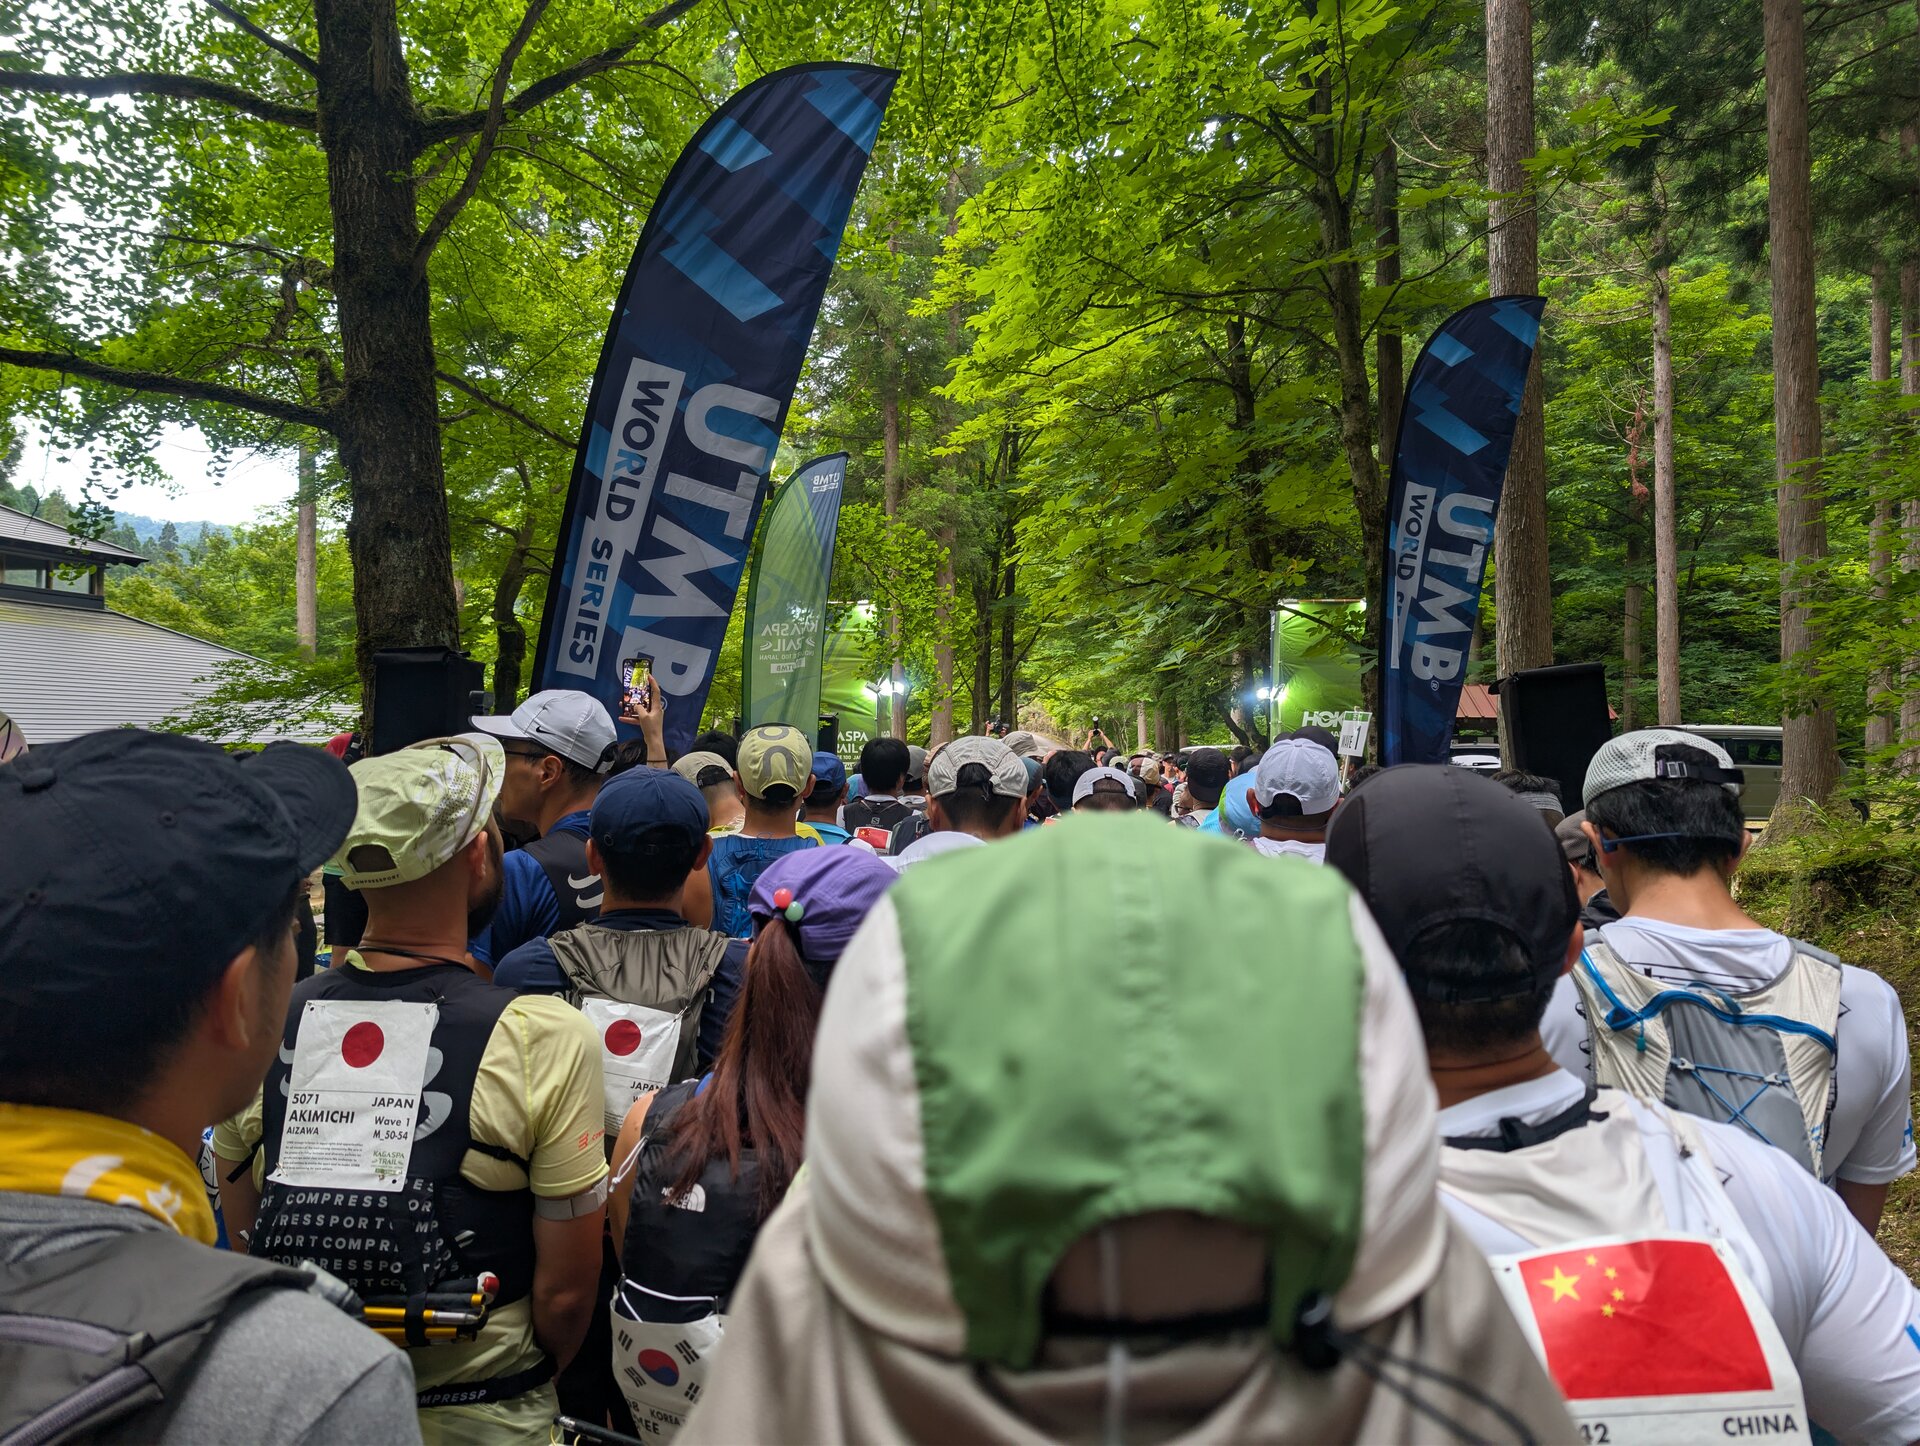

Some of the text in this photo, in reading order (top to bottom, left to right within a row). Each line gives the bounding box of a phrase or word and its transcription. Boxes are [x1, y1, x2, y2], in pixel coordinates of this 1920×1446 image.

[569, 380, 669, 665] WORLD SERIES
[1397, 494, 1428, 581] WORLD
[1411, 493, 1495, 682] UTMB
[1302, 711, 1345, 728] HOK
[837, 730, 869, 741] ASPA
[351, 873, 399, 885] COMPRESSPORT
[292, 1093, 414, 1109] 5071 JAPAN
[288, 1110, 410, 1127] AKIMICHI Wave 1
[286, 1126, 408, 1141] AIZAWA M_50-54
[379, 1158, 398, 1166] TRAIL
[650, 1408, 681, 1425] KOREA
[1723, 1414, 1799, 1437] CHINA
